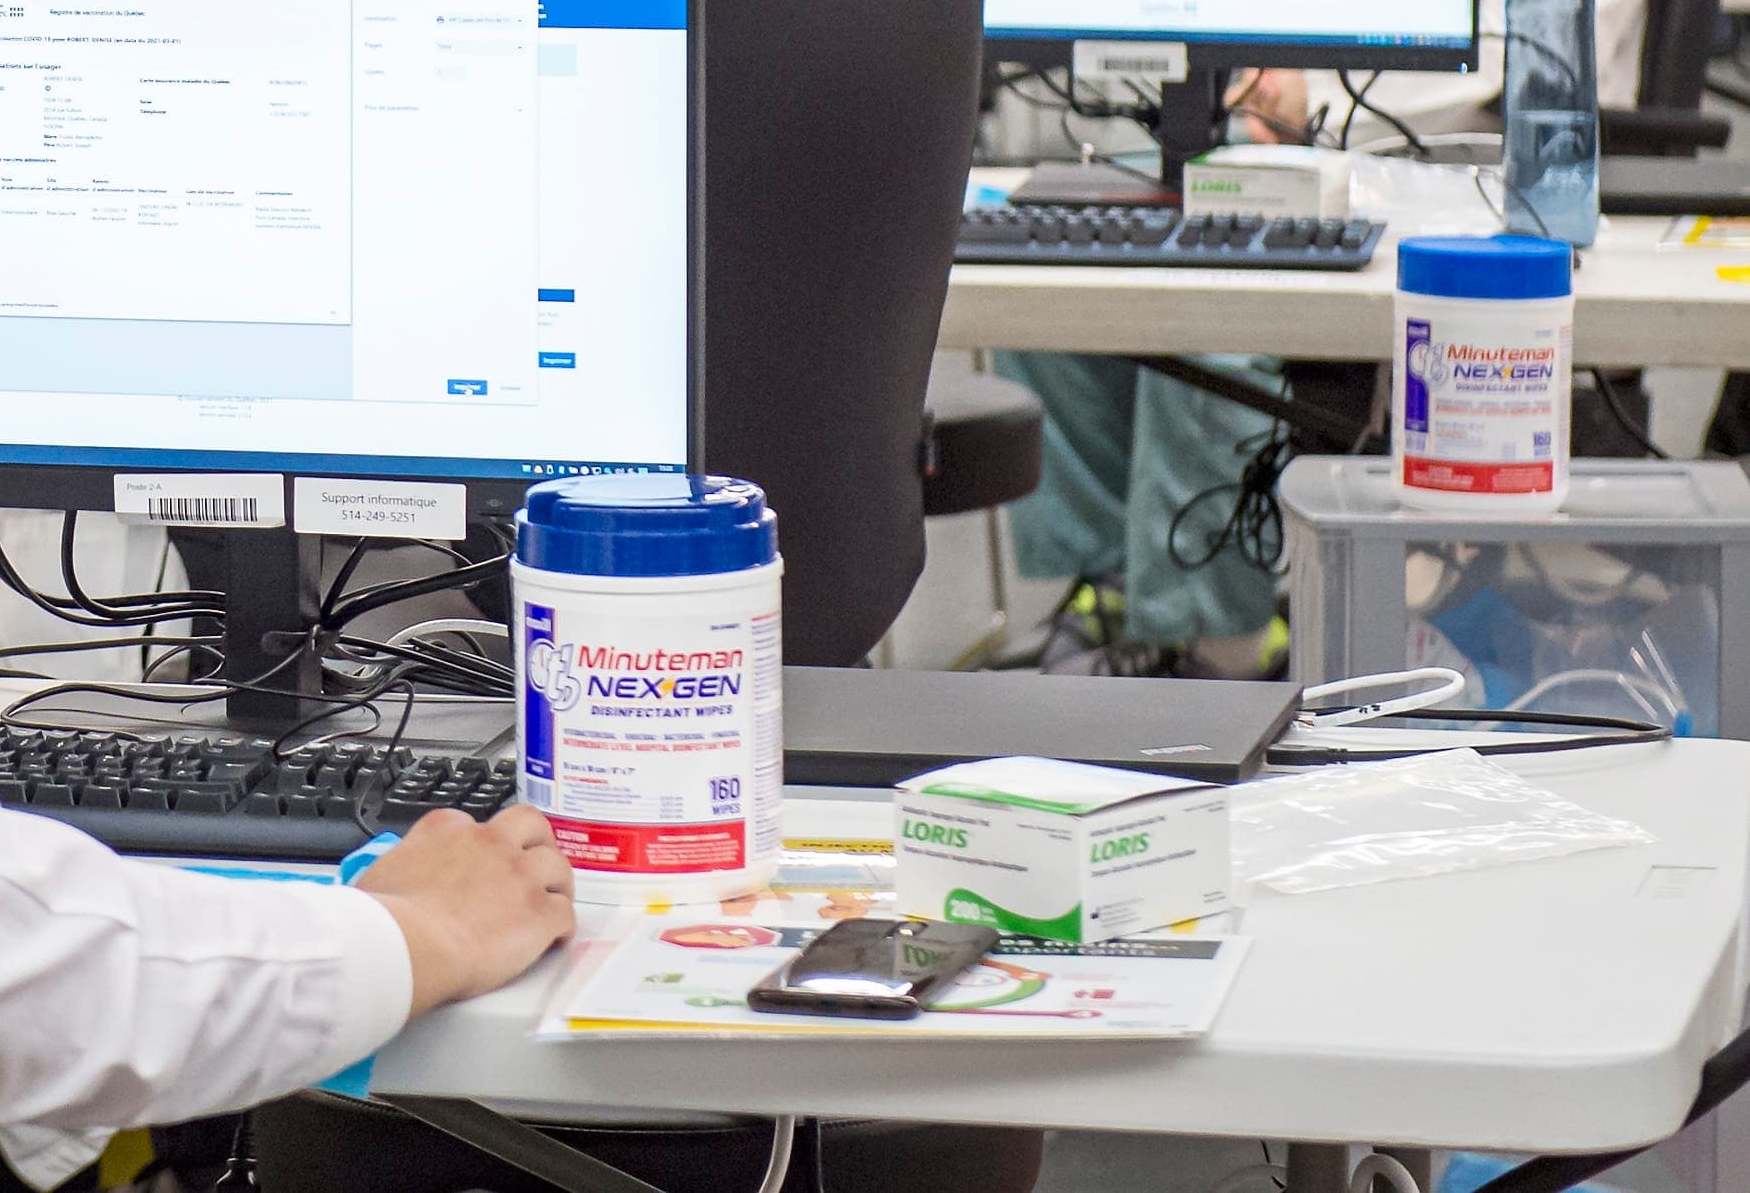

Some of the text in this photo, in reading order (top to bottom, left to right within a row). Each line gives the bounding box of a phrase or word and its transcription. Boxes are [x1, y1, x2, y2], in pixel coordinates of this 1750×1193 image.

[1447, 343, 1554, 362] Minuteman
[321, 492, 437, 511] Support informatique
[342, 510, 416, 524] 514-249-5251
[578, 645, 743, 671] Minuteman
[591, 704, 733, 718] DISINFECTANT WIPES
[709, 777, 740, 802] 160
[712, 805, 740, 815] WIPES
[902, 818, 968, 848] LORIS
[1090, 832, 1150, 864] LORIS
